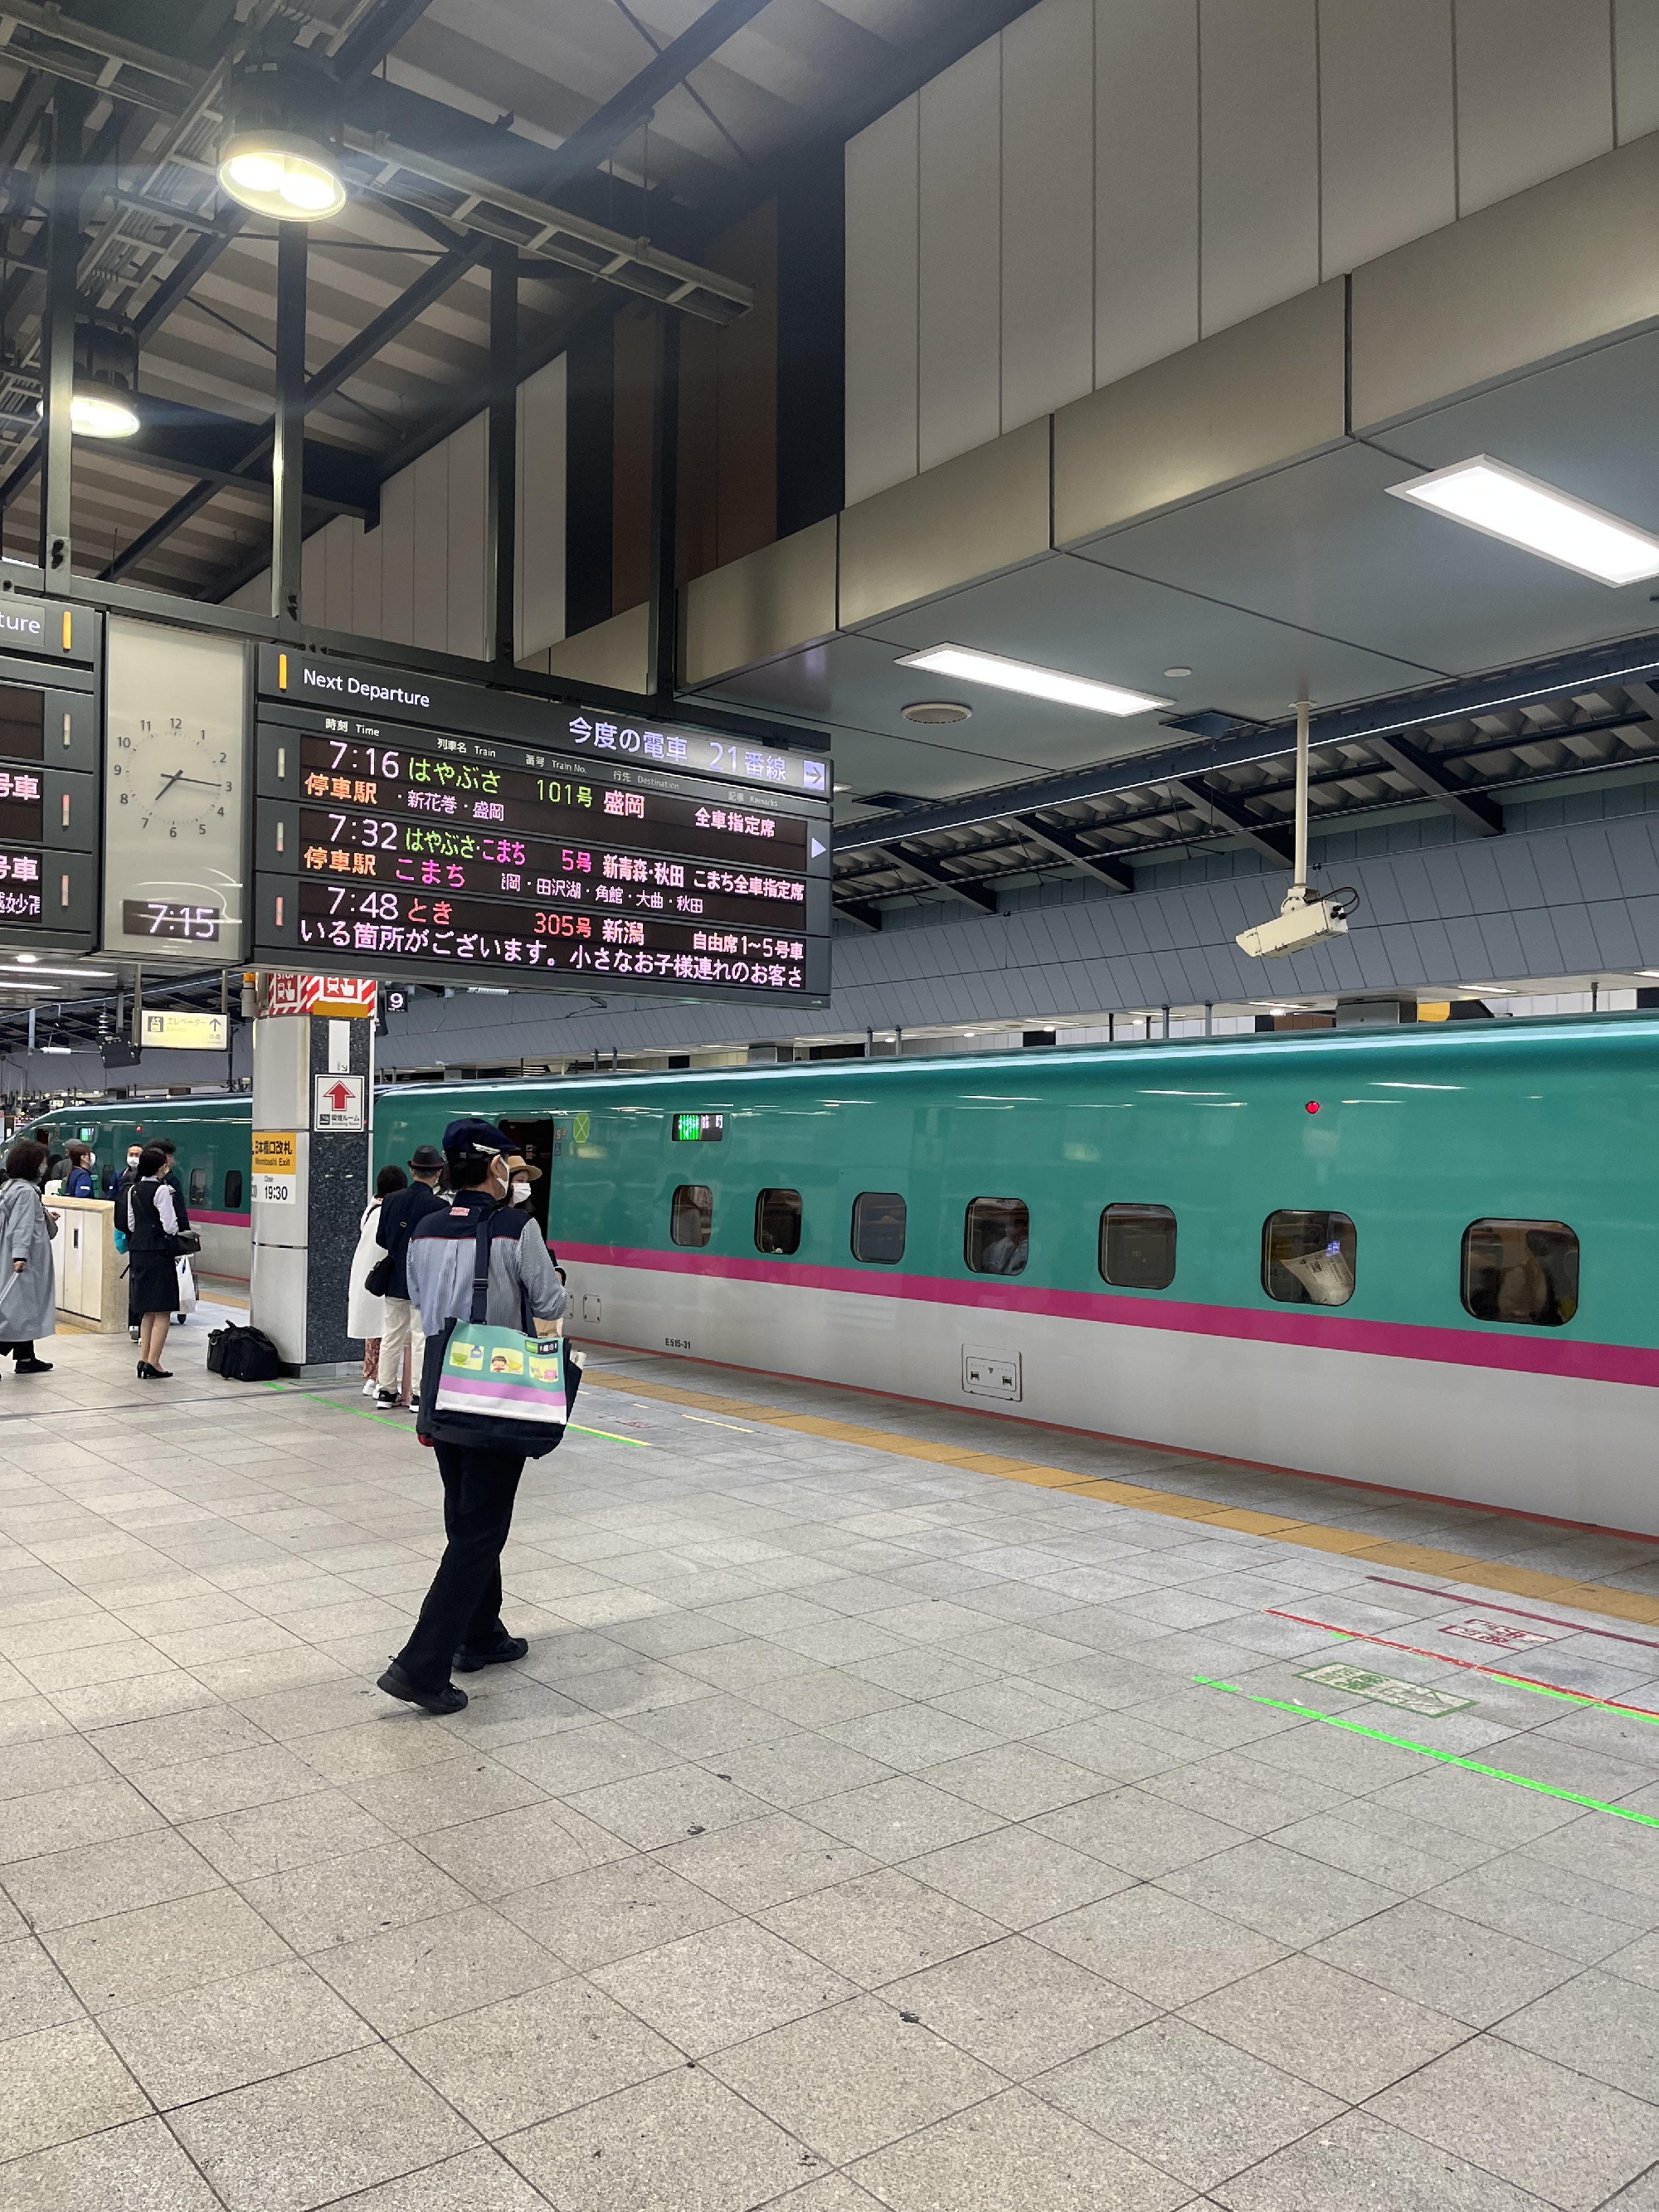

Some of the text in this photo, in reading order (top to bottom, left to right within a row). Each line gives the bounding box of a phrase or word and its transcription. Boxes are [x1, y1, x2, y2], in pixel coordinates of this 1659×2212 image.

[304, 669, 430, 708] Next Departure
[140, 719, 152, 732] 11
[168, 718, 182, 730] 12
[325, 718, 380, 736] 時刻 Time
[117, 737, 131, 748] 10
[200, 730, 206, 740] 1
[437, 738, 496, 758] 列車名 Train
[569, 717, 787, 782] 今度の電車 21番線
[219, 753, 227, 763] 2
[525, 754, 587, 773] 番号 Train No.
[114, 764, 122, 776] 9
[225, 782, 232, 792] 3
[613, 770, 679, 790] 行先 Destination
[304, 772, 377, 805] 停車駅
[329, 740, 776, 838] 7:16 はやぶさ 101号 盛岡 全車指定席
[120, 793, 129, 805] 8
[728, 791, 778, 807] 記事 Remarks
[216, 806, 225, 816] 4
[141, 818, 149, 829] 7
[199, 825, 207, 836] 5
[169, 826, 177, 838] 6
[328, 813, 398, 851] 7:32
[562, 849, 592, 873] 5号
[693, 870, 805, 902] こまち全車指定席
[304, 845, 377, 876] 停車駅
[395, 857, 465, 888] こまち
[148, 903, 215, 938] 7:15
[328, 886, 399, 920] 7:48
[407, 897, 454, 925] とき
[533, 912, 592, 938] 305号
[602, 918, 645, 946] 新潟
[390, 992, 404, 1009] 9
[279, 1157, 290, 1167] Exit
[265, 1186, 288, 1201] 19:30
